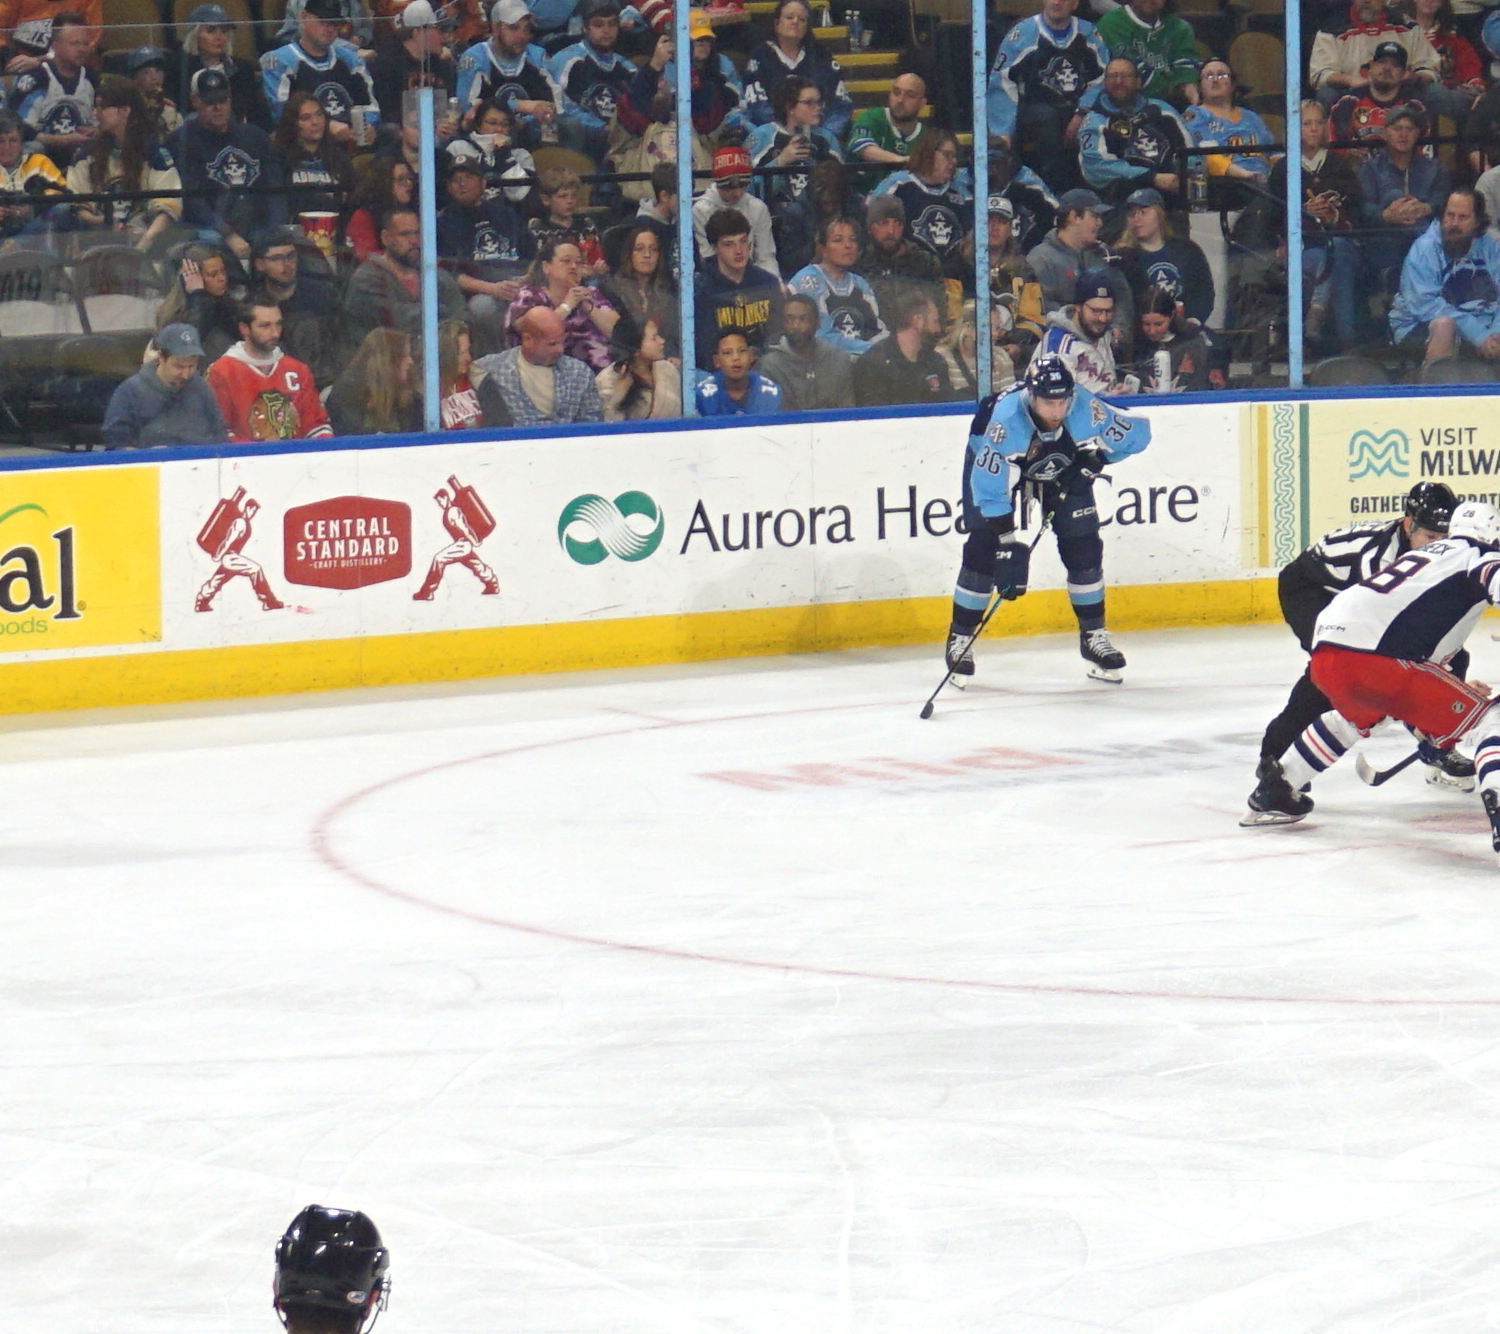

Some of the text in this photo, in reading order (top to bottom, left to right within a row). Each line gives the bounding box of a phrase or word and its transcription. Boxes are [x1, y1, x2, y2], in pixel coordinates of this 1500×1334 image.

[285, 371, 299, 391] C
[1420, 427, 1478, 447] VISIT
[976, 447, 1002, 475] 36
[304, 517, 392, 540] CENTRAL
[680, 483, 1199, 555] Aurora Care
[296, 536, 400, 561] STANDARD
[1357, 554, 1432, 595] 8
